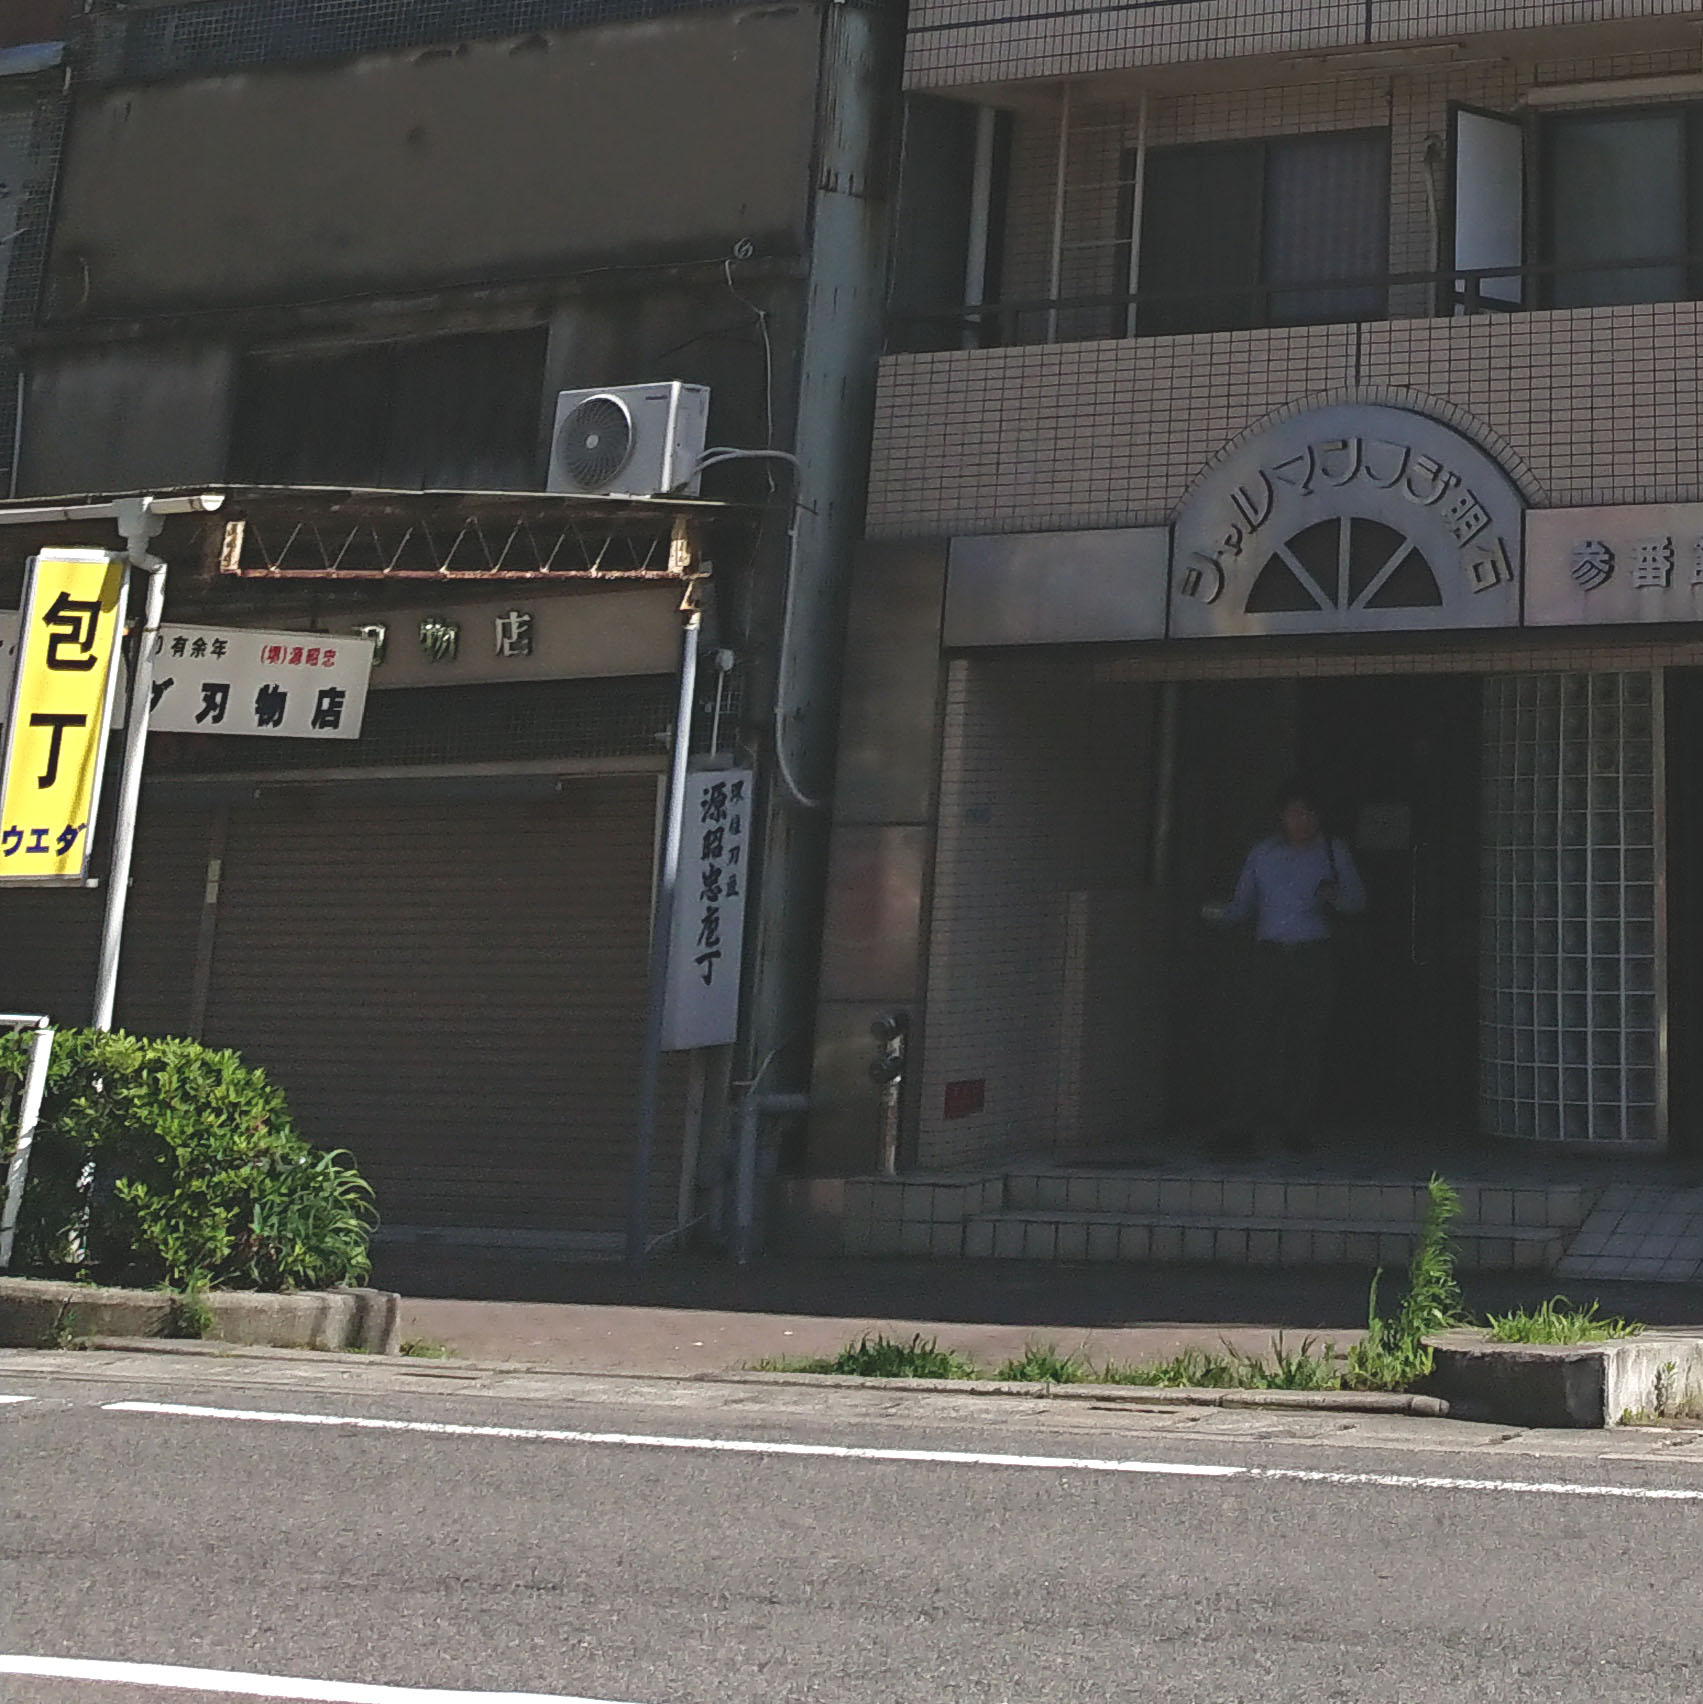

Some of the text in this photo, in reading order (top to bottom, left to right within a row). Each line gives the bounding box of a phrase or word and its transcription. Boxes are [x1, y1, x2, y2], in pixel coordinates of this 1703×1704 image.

[28, 591, 103, 789] 包丁
[1, 823, 87, 858] ウエダ
